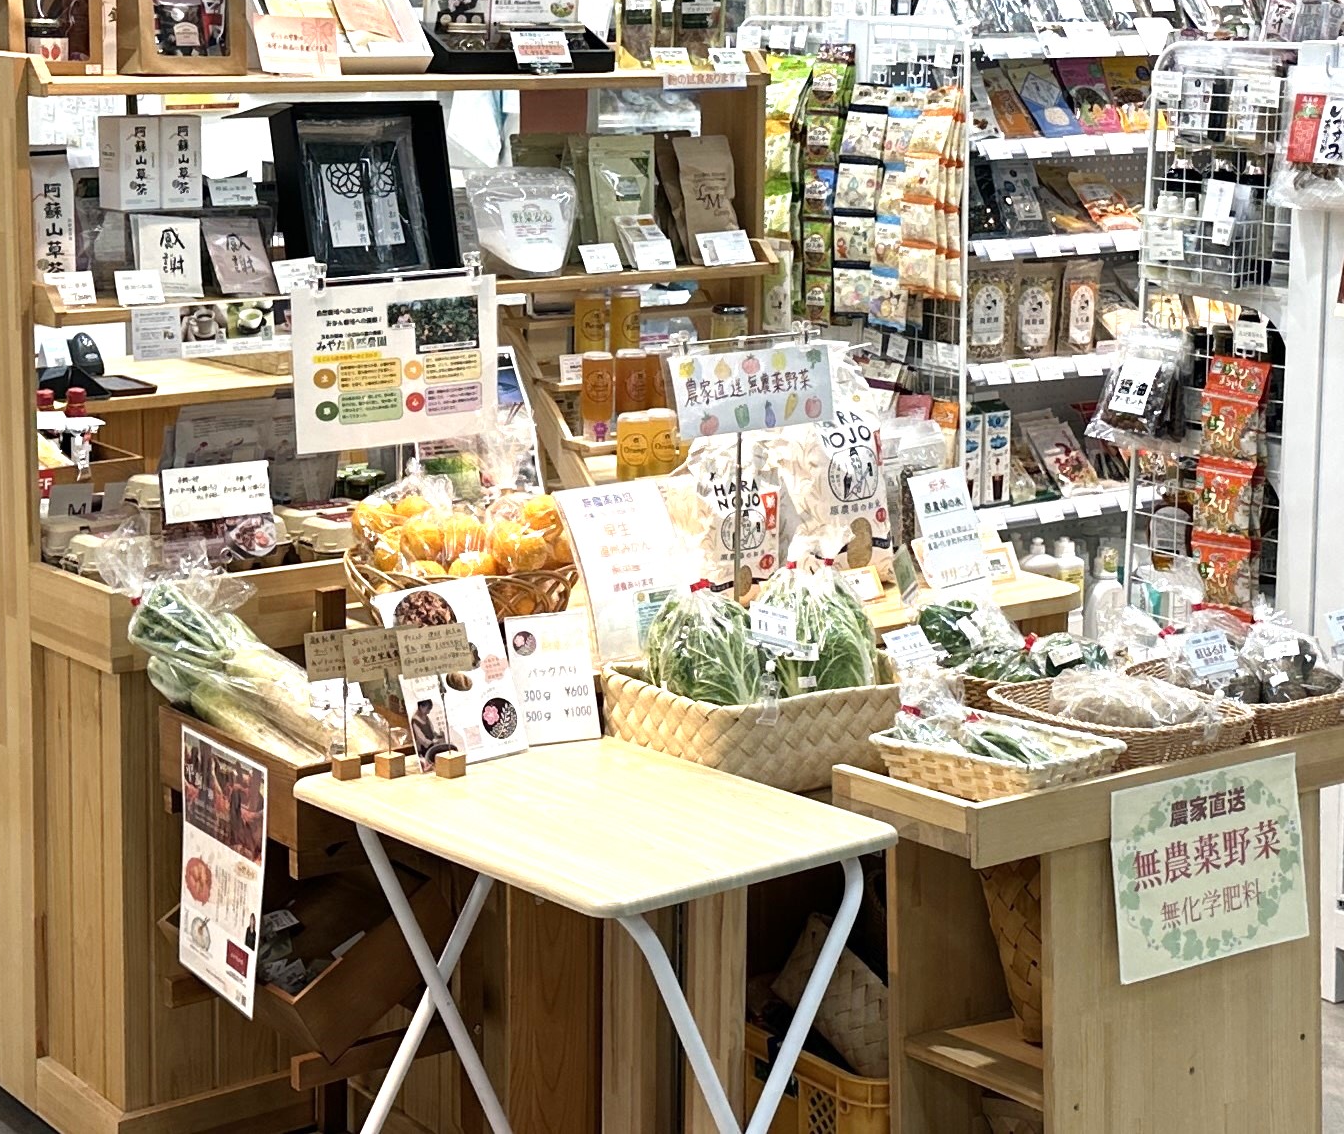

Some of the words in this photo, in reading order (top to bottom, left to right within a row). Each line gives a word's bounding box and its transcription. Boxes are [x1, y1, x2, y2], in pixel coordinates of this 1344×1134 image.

[134, 125, 148, 196] 阿蘇山草茶
[177, 125, 191, 195] 阿蘇山草茶
[43, 182, 65, 273] 阿蘇山草茶
[159, 226, 186, 276] 感謝
[822, 424, 872, 449] NOJO
[713, 478, 759, 497] HARA
[716, 492, 761, 511] NOJO
[523, 690, 552, 702] 300g
[564, 685, 589, 697] ¥600
[525, 711, 552, 722] 500g
[563, 705, 593, 717] ¥1000
[1170, 786, 1246, 828] 農家直送
[1133, 819, 1281, 892] 無農薬野菜
[1161, 878, 1261, 930] 無化学肥料
